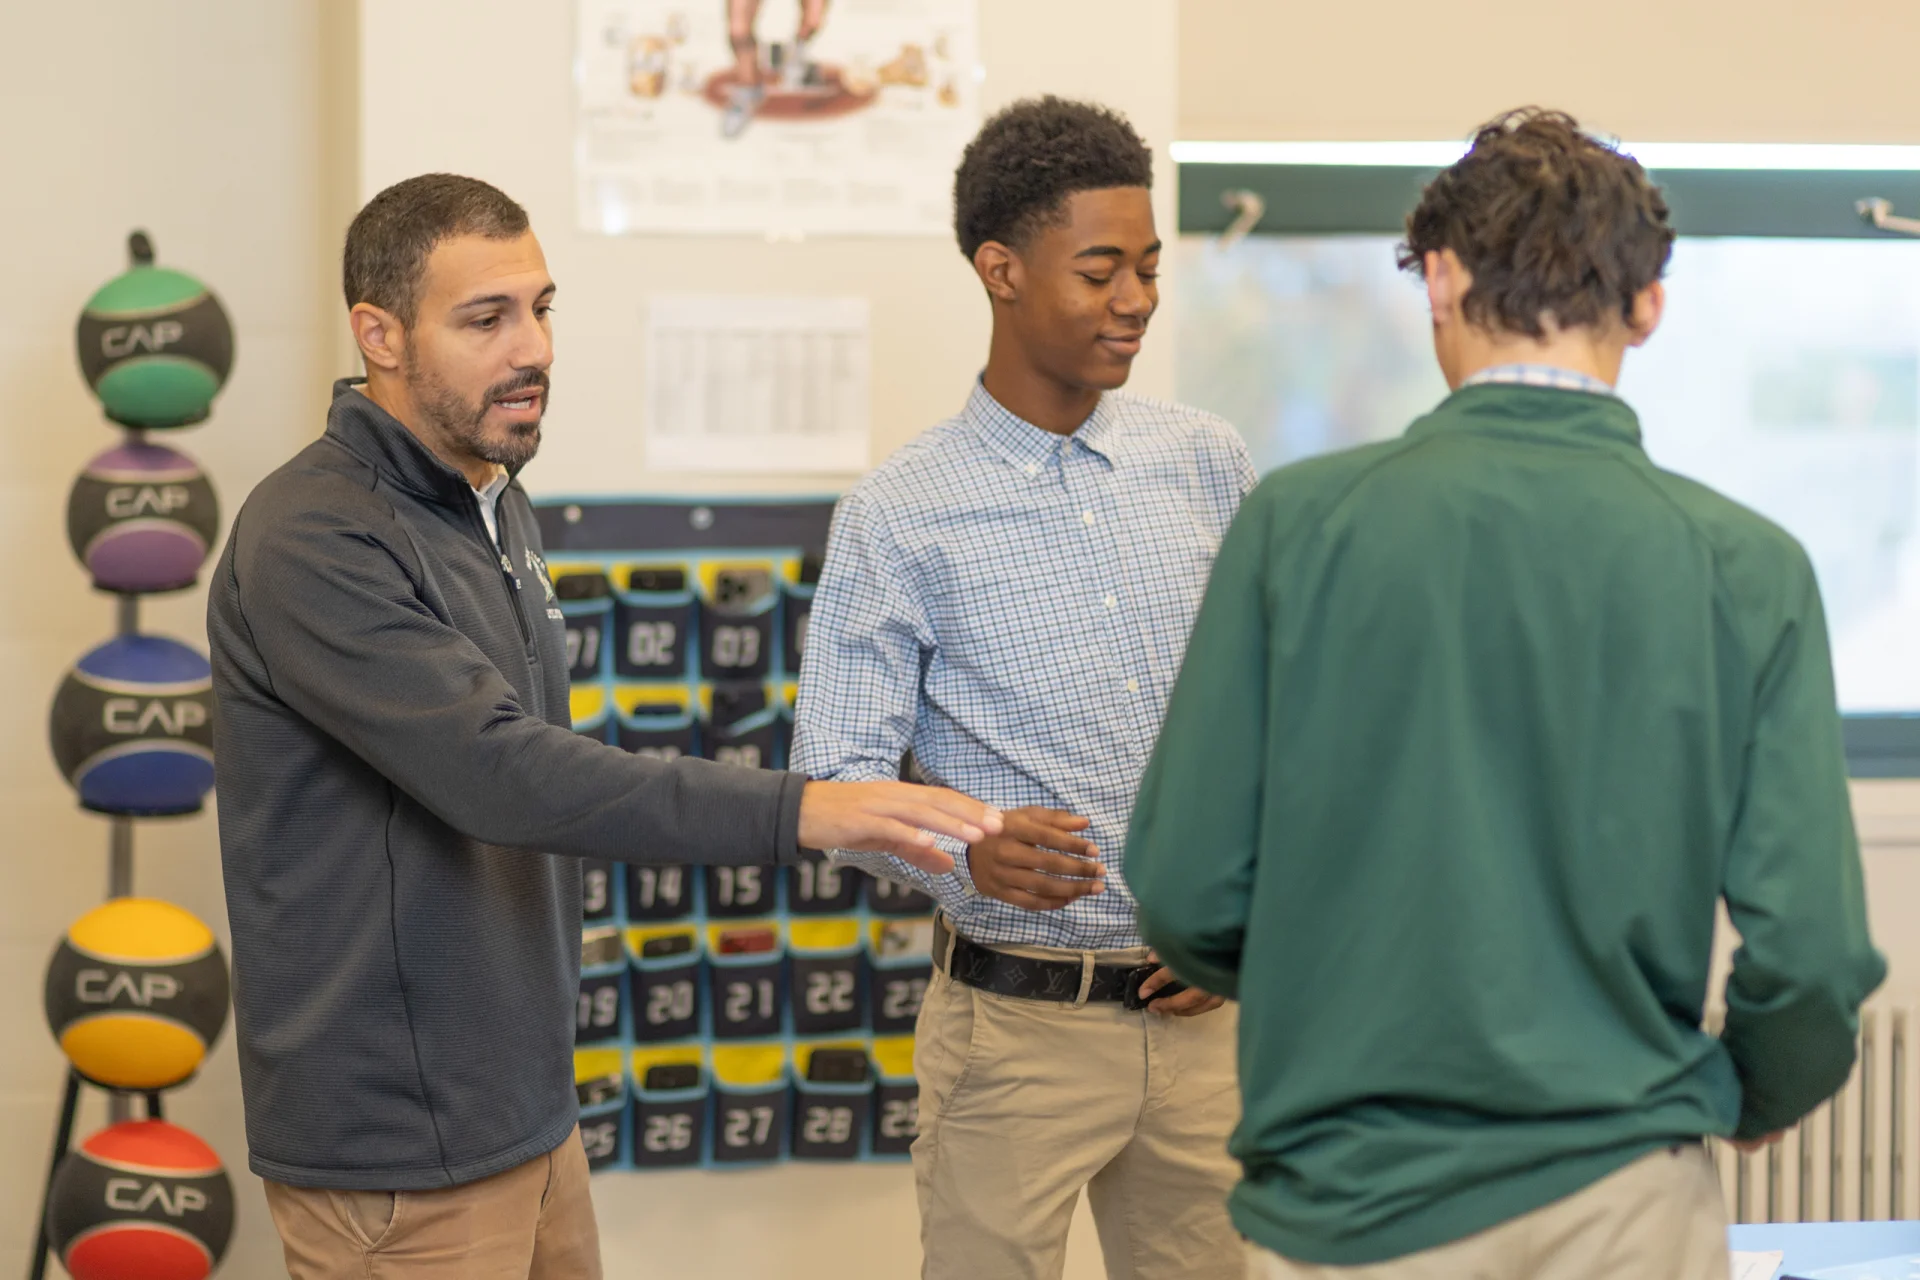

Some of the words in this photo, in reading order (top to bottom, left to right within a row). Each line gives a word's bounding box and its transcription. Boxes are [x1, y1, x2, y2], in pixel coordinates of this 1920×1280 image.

[101, 321, 183, 358] CAP
[106, 486, 189, 518] CAP
[628, 621, 676, 667] 02
[712, 626, 760, 667] 03
[103, 698, 205, 735] CAP
[584, 869, 607, 912] 3
[639, 867, 682, 908] 14
[716, 865, 761, 906] 15
[800, 860, 841, 901] 16
[76, 969, 178, 1006] CAP
[577, 985, 618, 1028] 19
[647, 979, 694, 1025] 20
[725, 978, 774, 1022] 21
[806, 970, 855, 1015] 22
[644, 1113, 692, 1152] 26
[724, 1106, 774, 1147] 27
[803, 1106, 853, 1143] 28
[104, 1178, 208, 1216] CAP
